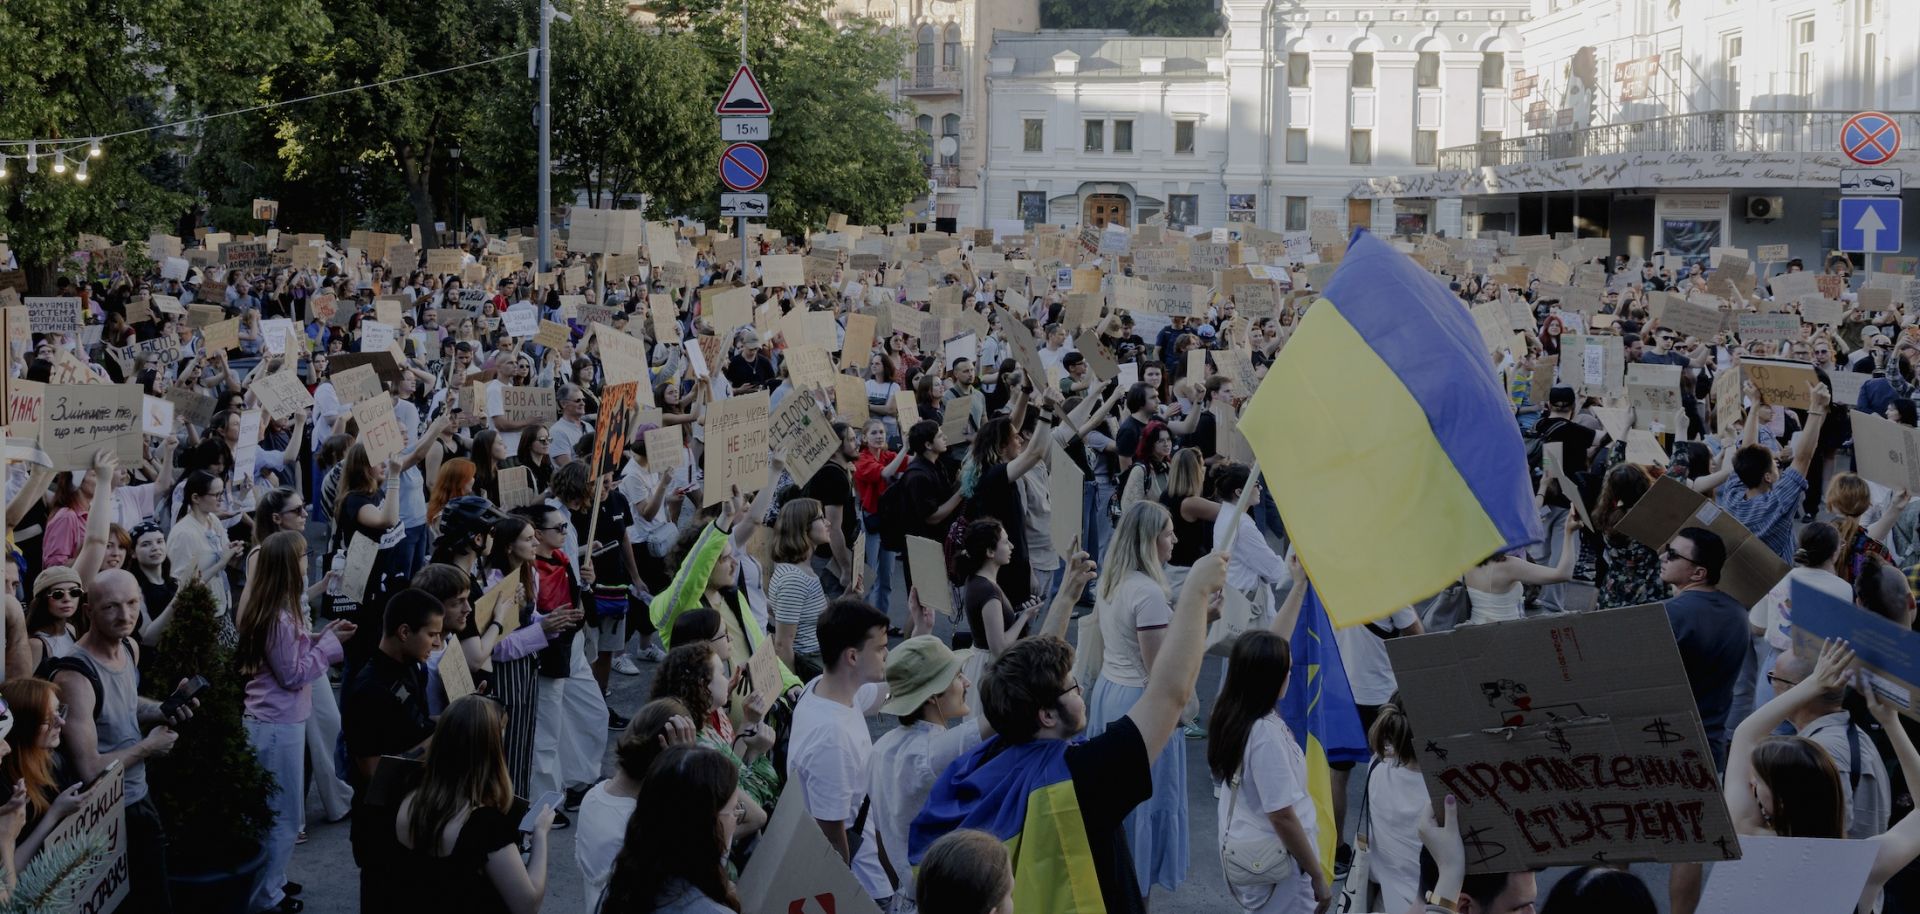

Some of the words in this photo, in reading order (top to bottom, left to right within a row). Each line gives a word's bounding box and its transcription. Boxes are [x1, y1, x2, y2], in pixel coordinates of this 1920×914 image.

[504, 390, 537, 407] ВОВА
[541, 392, 553, 407] НЕ
[727, 434, 740, 454] НЕ
[1513, 800, 1705, 855] СТУДЕНТ
